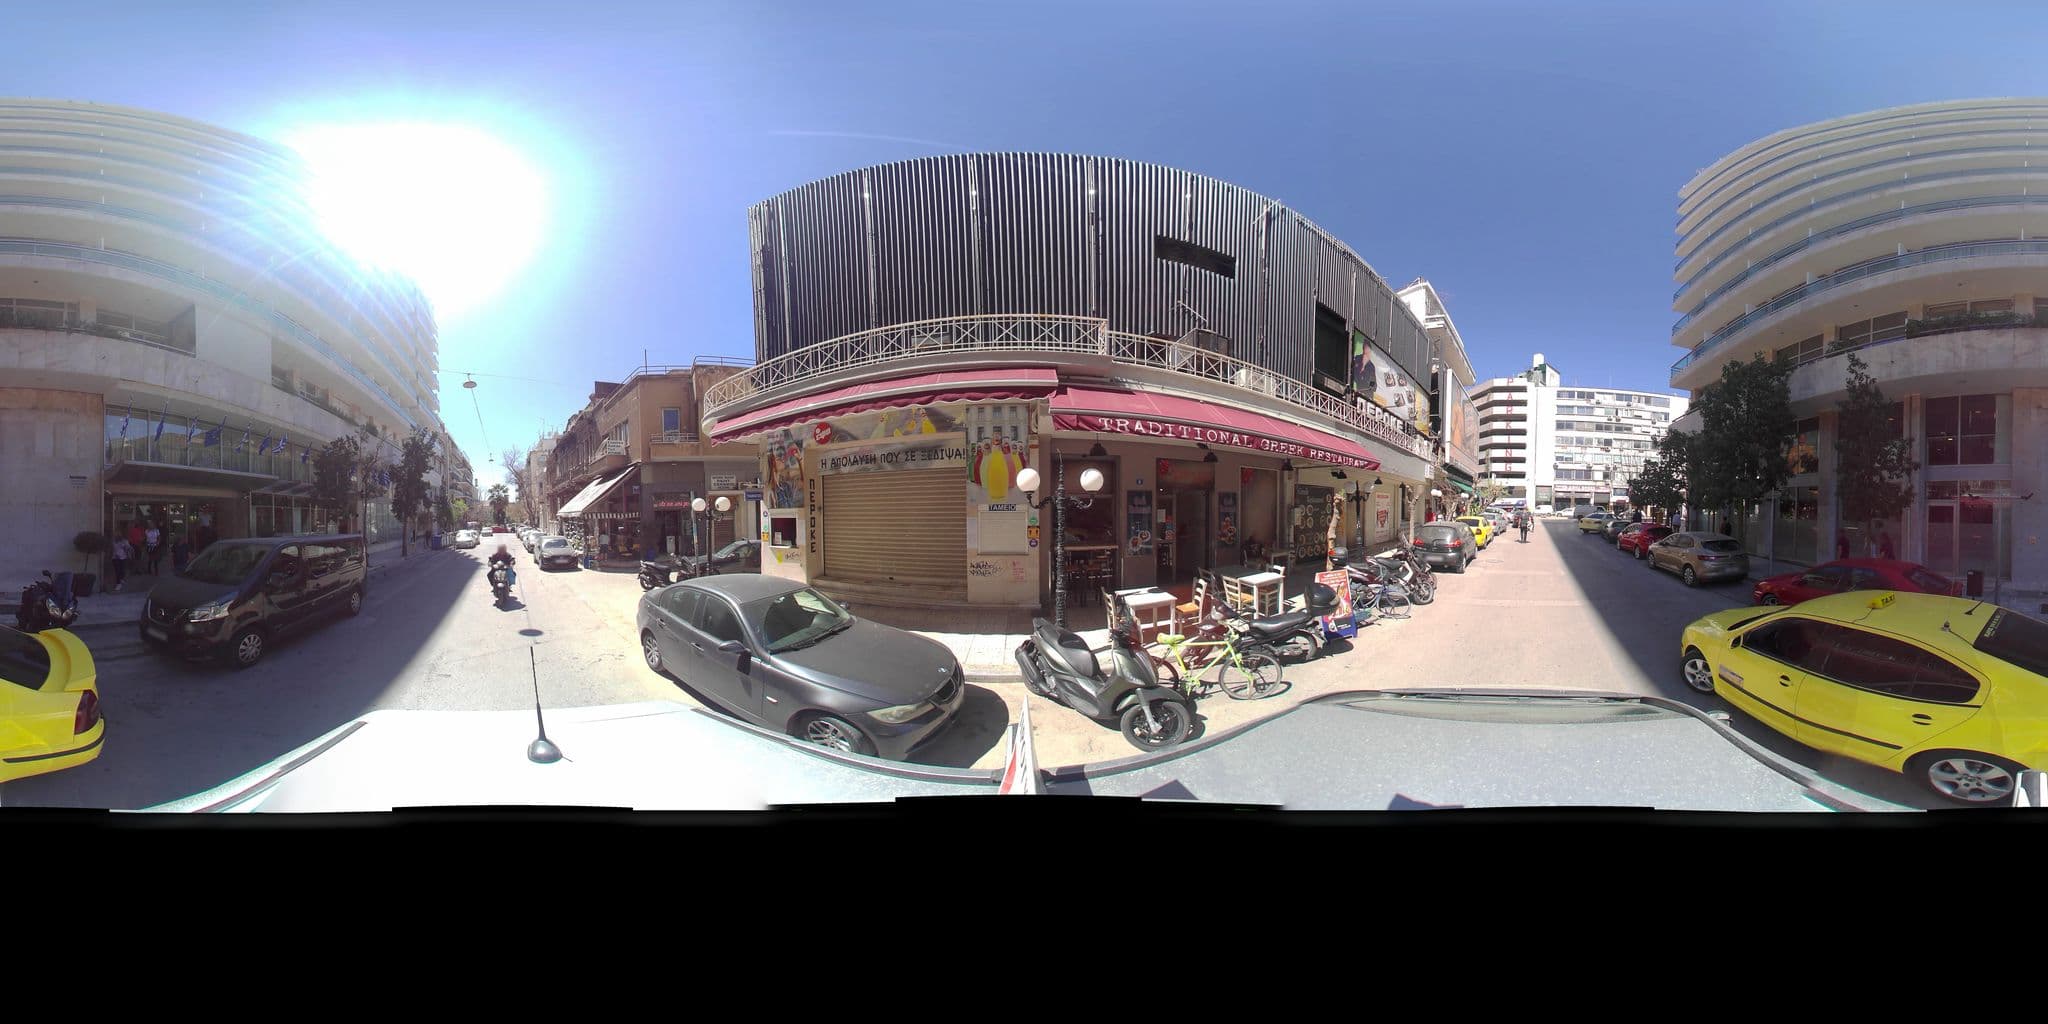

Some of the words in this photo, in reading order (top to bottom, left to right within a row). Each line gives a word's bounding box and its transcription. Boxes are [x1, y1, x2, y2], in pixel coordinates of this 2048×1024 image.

[1099, 417, 1253, 448] TRADITIONAL
[1260, 439, 1304, 457] GREEK
[830, 453, 877, 468] ΑΠΟΛΑΥΣΗ
[880, 452, 900, 464] ΠΟΥ
[904, 450, 917, 462] ΣΕ
[920, 447, 966, 461] ΞΕΔΙΨΑ!
[809, 479, 817, 553] ΠΕΡΟΚΕ
[1881, 592, 1895, 604] TAXI
